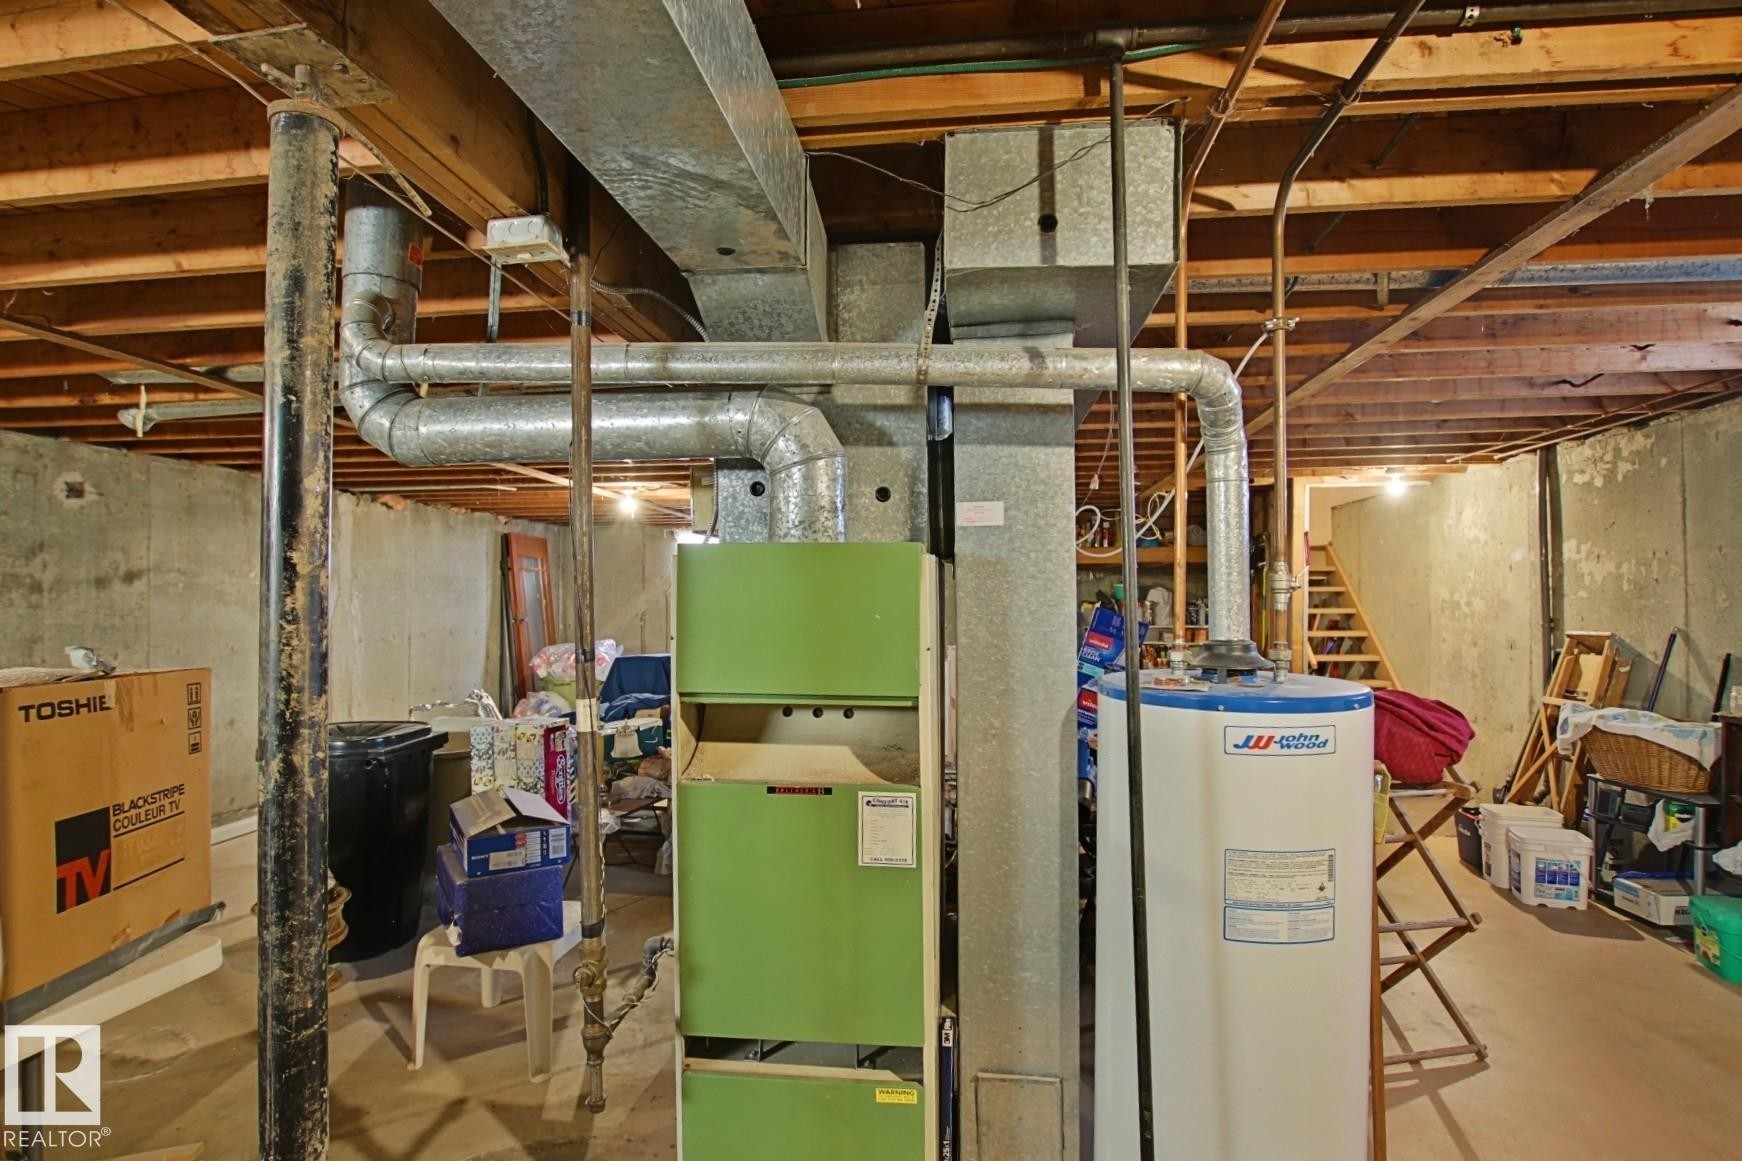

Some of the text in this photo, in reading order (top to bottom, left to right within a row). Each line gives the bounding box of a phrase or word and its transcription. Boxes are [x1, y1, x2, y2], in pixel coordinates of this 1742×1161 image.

[112, 783, 185, 817] BLACKSTRIPE
[113, 799, 181, 832] COULEUR TV
[56, 849, 111, 910] TV
[943, 1031, 951, 1045] 3M
[878, 1089, 915, 1097] WARNING
